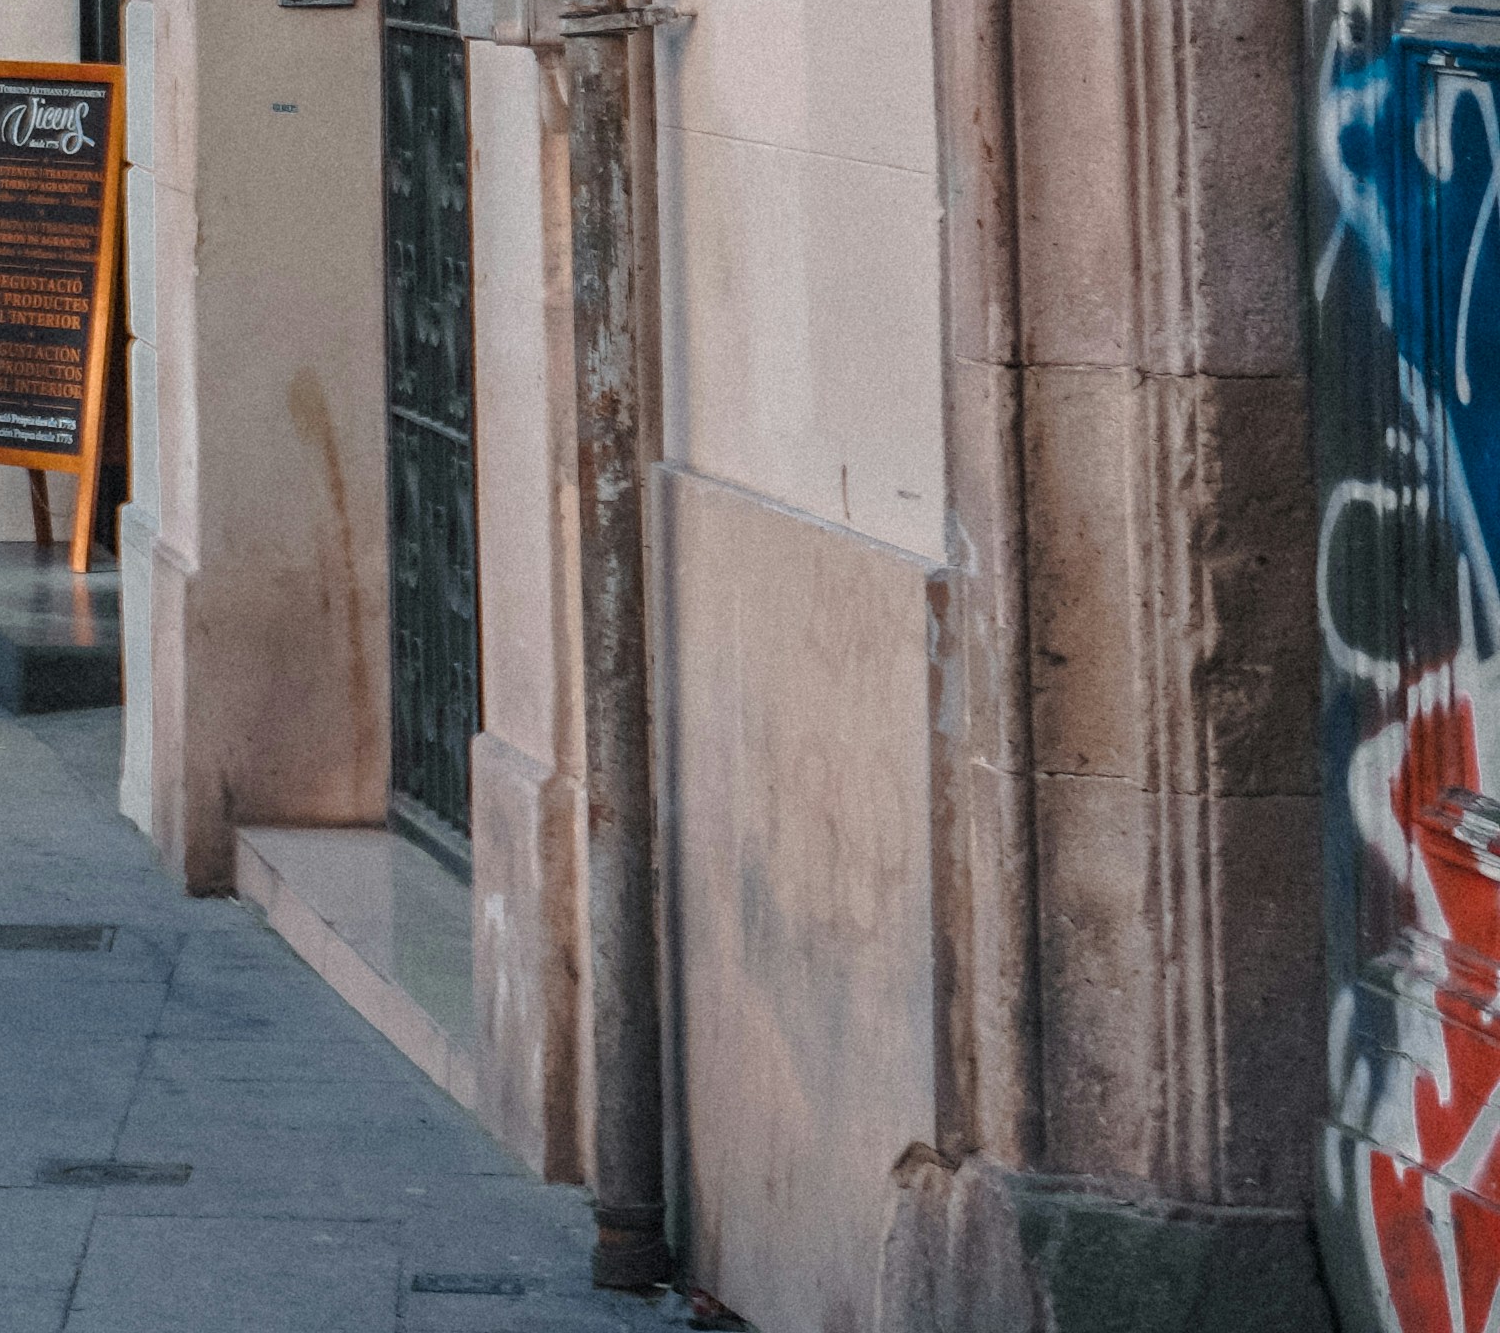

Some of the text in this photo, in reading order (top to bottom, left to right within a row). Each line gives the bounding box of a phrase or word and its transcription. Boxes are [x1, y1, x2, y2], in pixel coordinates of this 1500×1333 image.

[2, 98, 96, 155] Vicens
[3, 292, 90, 312] PRODUCTES
[15, 379, 83, 400] INTERIOR
